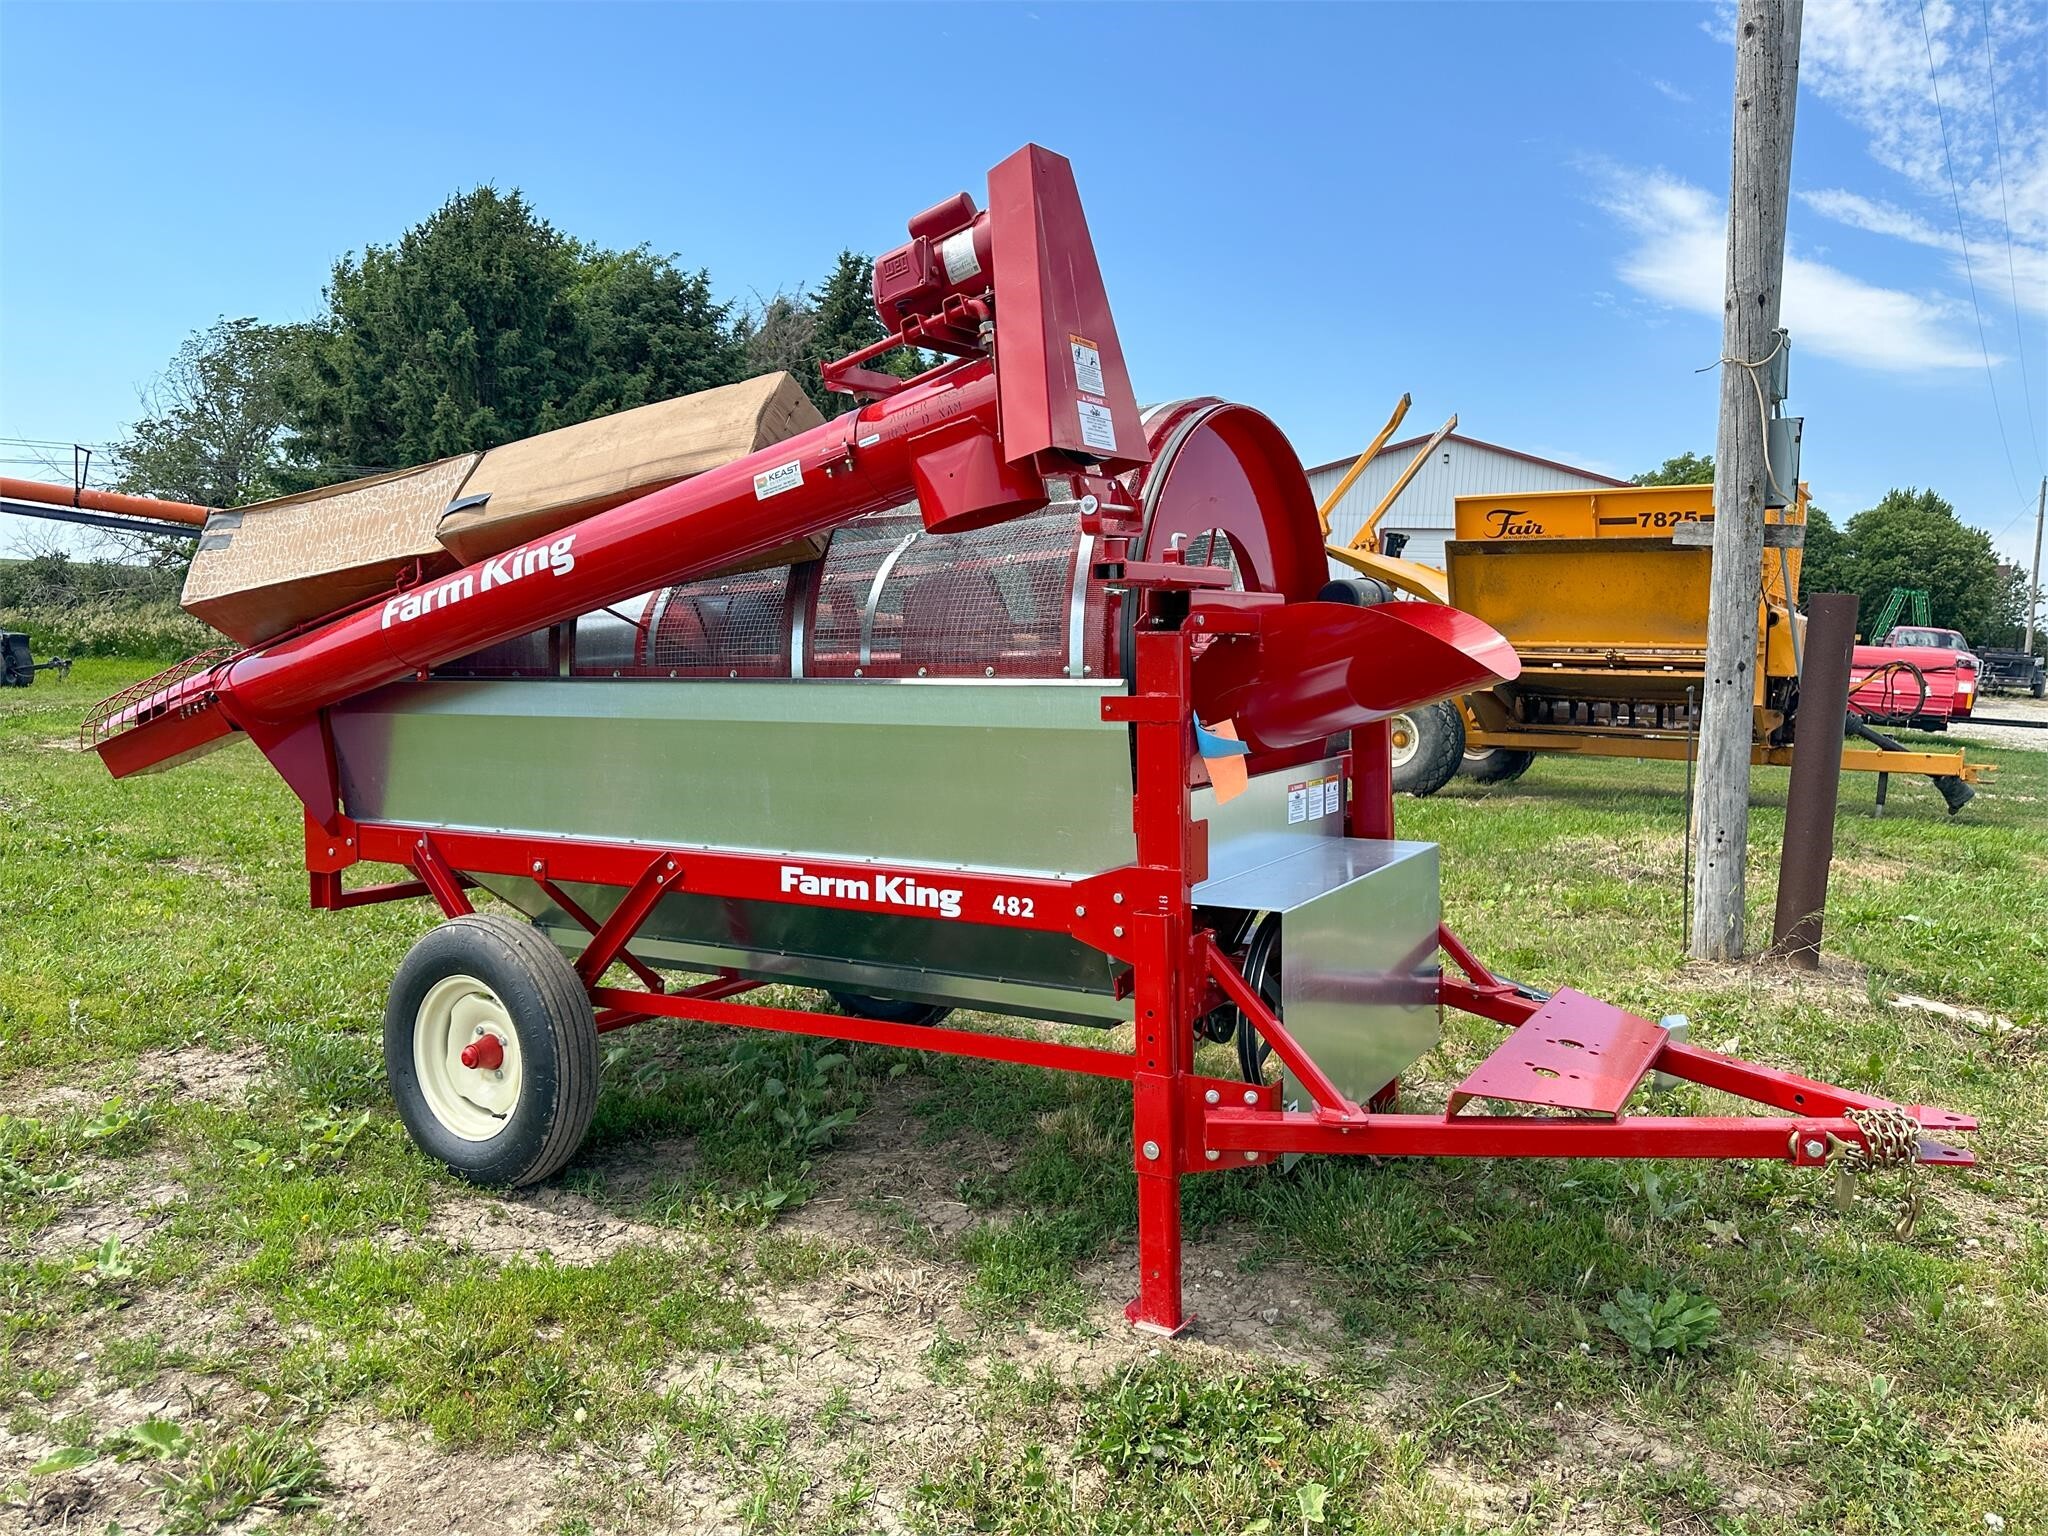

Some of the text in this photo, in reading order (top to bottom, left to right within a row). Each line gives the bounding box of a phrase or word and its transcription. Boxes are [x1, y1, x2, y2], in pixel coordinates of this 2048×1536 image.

[768, 463, 799, 481] KEAST
[1483, 509, 1545, 538] Fair
[1638, 511, 1698, 528] 7825
[382, 534, 577, 630] Farm King
[780, 865, 963, 918] Farm King
[992, 895, 1035, 919] 482
